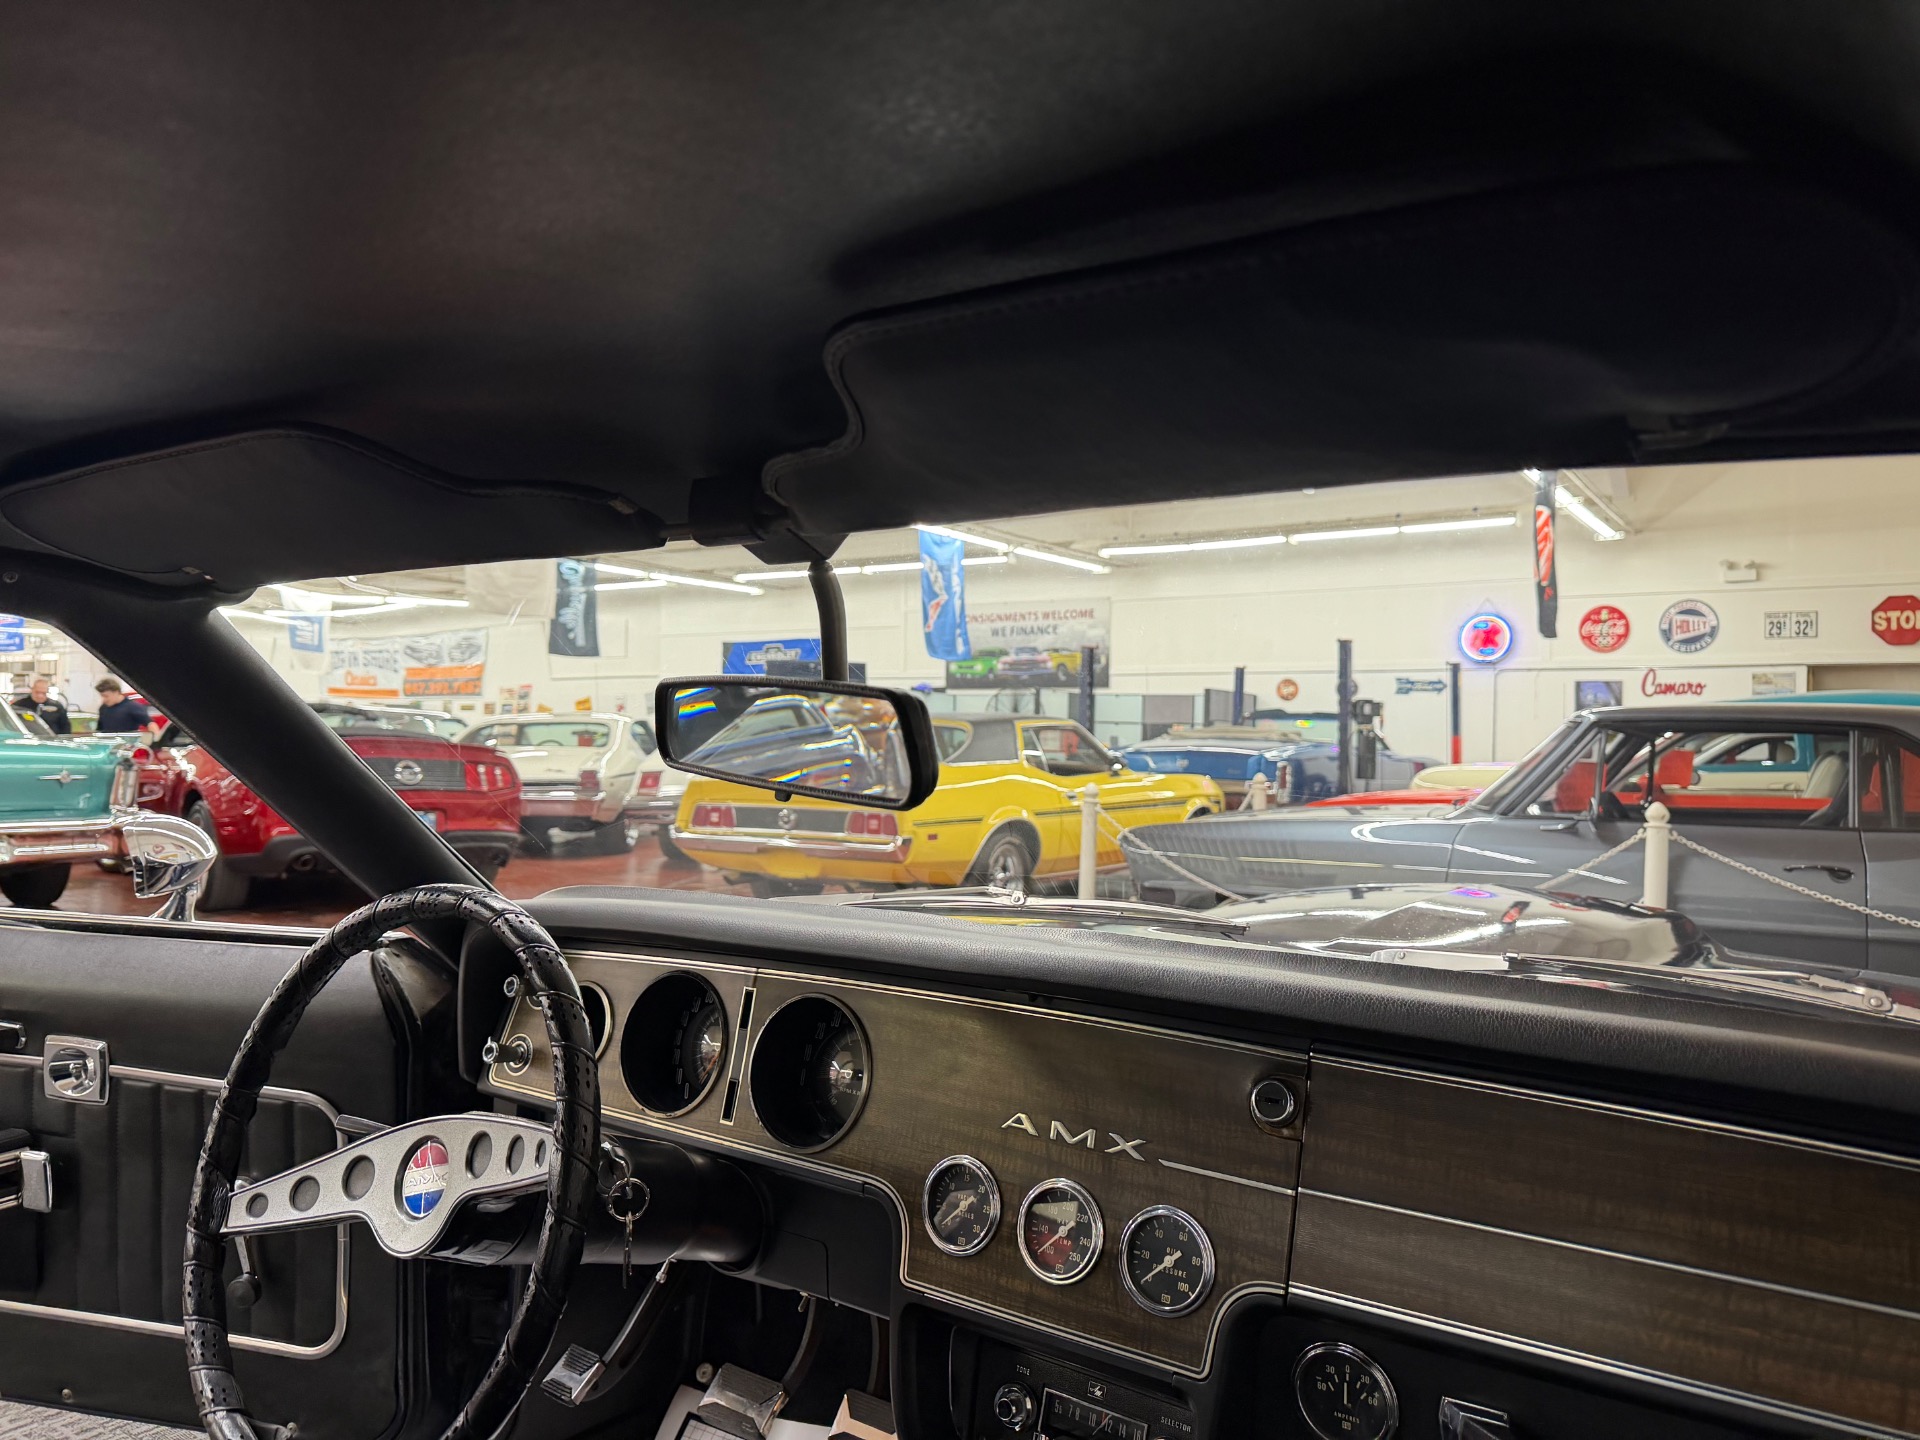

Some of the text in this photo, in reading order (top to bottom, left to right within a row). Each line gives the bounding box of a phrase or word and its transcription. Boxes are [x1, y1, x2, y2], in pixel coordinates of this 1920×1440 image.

[966, 608, 1095, 624] ONSIGNMENTS WELCOME
[990, 624, 1058, 637] WE FINANCE
[1675, 616, 1707, 636] HOLLEY
[1641, 668, 1706, 697] Camaro
[1000, 1112, 1147, 1162] AMX
[978, 1184, 986, 1194] 20
[982, 1205, 990, 1214] 25
[1076, 1214, 1088, 1222] 220
[972, 1224, 980, 1233] 30
[1154, 1230, 1164, 1238] 40
[1178, 1232, 1188, 1242] 60
[1080, 1236, 1091, 1246] 240
[1069, 1252, 1080, 1262] 250
[1141, 1250, 1150, 1259] 20
[1192, 1256, 1200, 1266] 80
[1178, 1282, 1188, 1292] 100
[1016, 1364, 1030, 1376] TONE
[1326, 1364, 1335, 1374] 30
[1346, 1364, 1350, 1373] 0
[1360, 1374, 1370, 1384] 30
[1317, 1382, 1326, 1390] 60
[1368, 1396, 1378, 1406] 60
[1334, 1411, 1360, 1424] AMPERES
[1088, 1412, 1097, 1427] 10
[1104, 1418, 1112, 1433] 12
[1119, 1422, 1126, 1438] 14
[1160, 1416, 1192, 1433] SELECTOR
